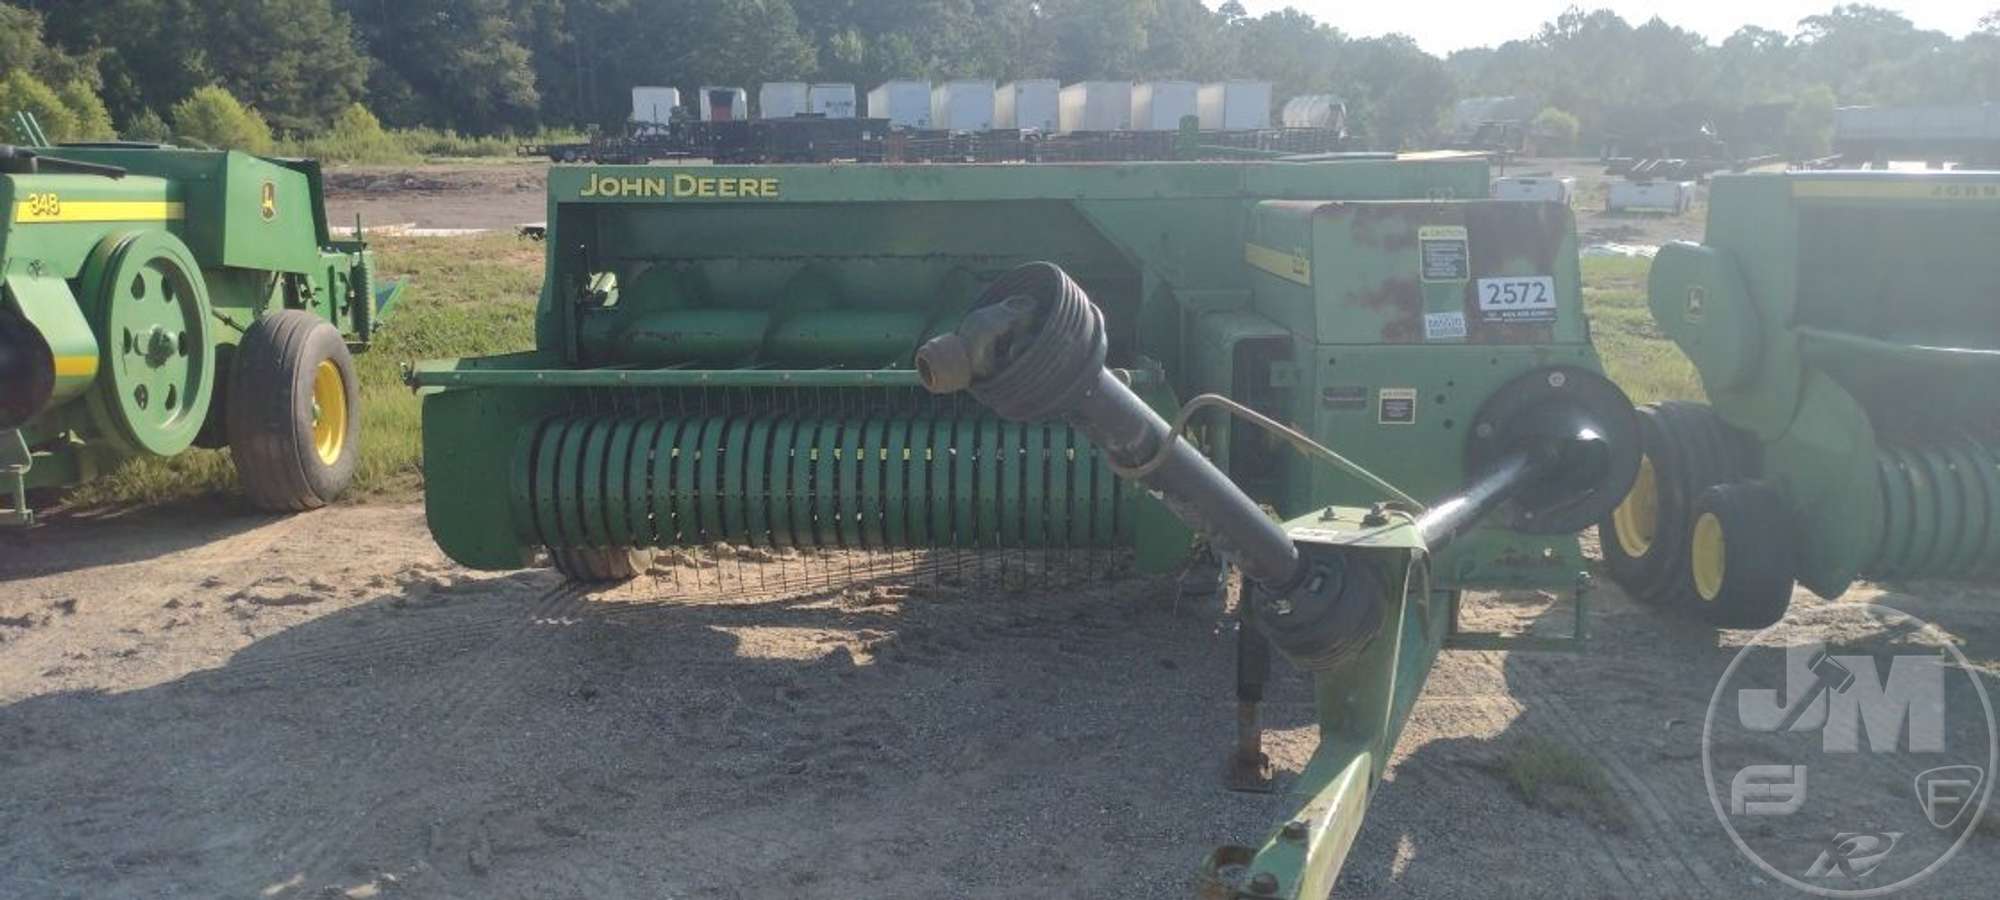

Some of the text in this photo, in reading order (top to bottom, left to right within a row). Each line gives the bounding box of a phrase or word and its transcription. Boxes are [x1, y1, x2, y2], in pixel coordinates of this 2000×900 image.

[580, 173, 780, 198] JOHN DEERE
[1486, 281, 1548, 305] 2572
